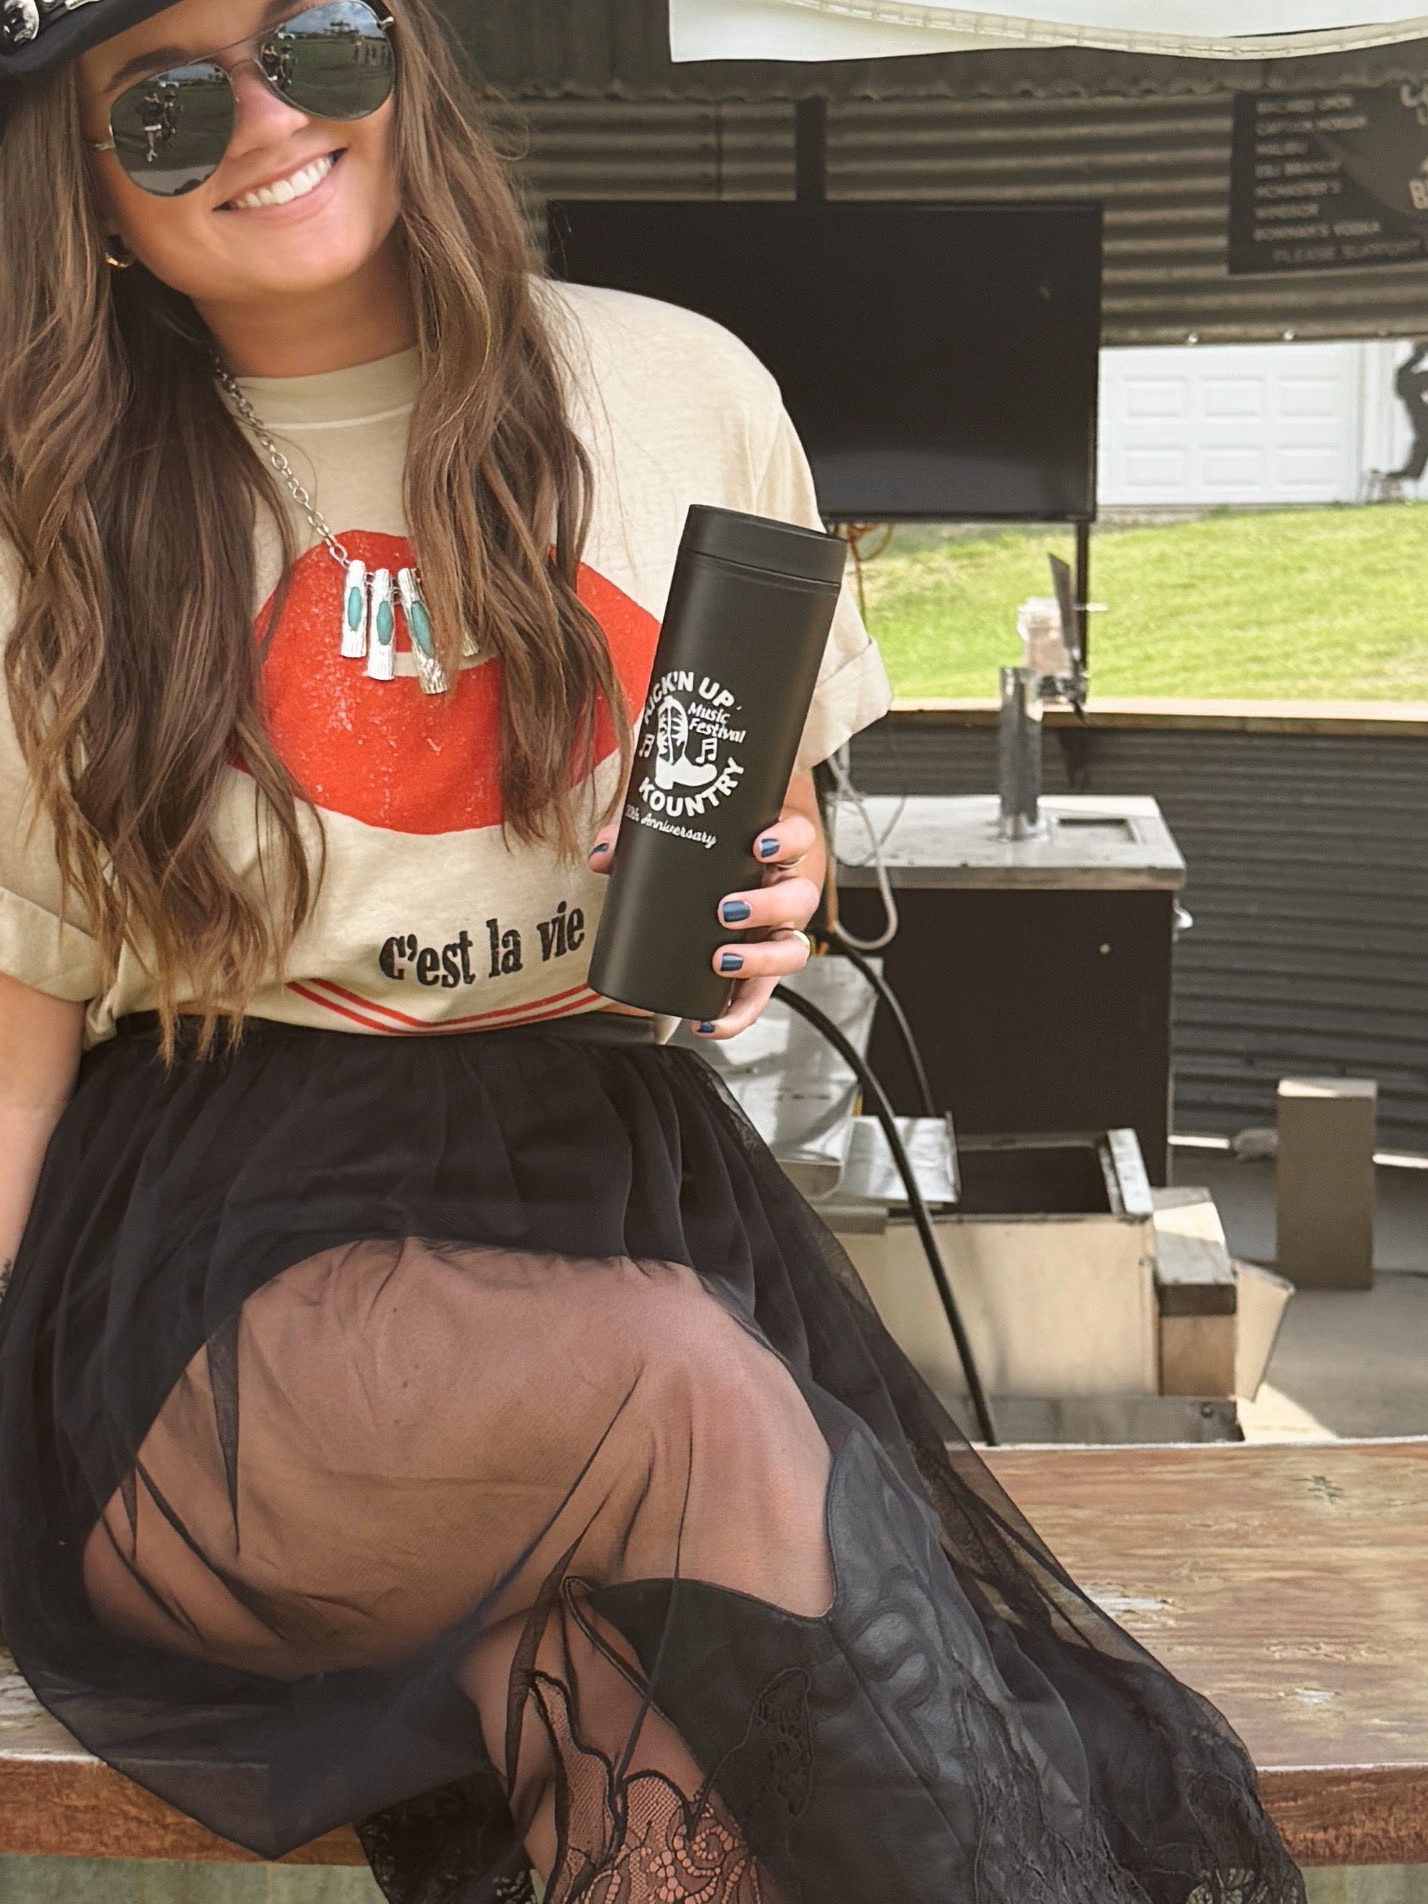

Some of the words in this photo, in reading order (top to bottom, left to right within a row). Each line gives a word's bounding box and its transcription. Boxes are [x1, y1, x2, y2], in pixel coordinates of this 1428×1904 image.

[698, 676, 735, 707] UP
[687, 701, 731, 725] Music
[689, 717, 747, 744] Festival
[638, 756, 745, 817] KOUNTRY
[640, 812, 717, 849] Anniversary
[378, 930, 476, 989] C'est
[486, 917, 524, 979] la
[536, 900, 586, 962] vie
